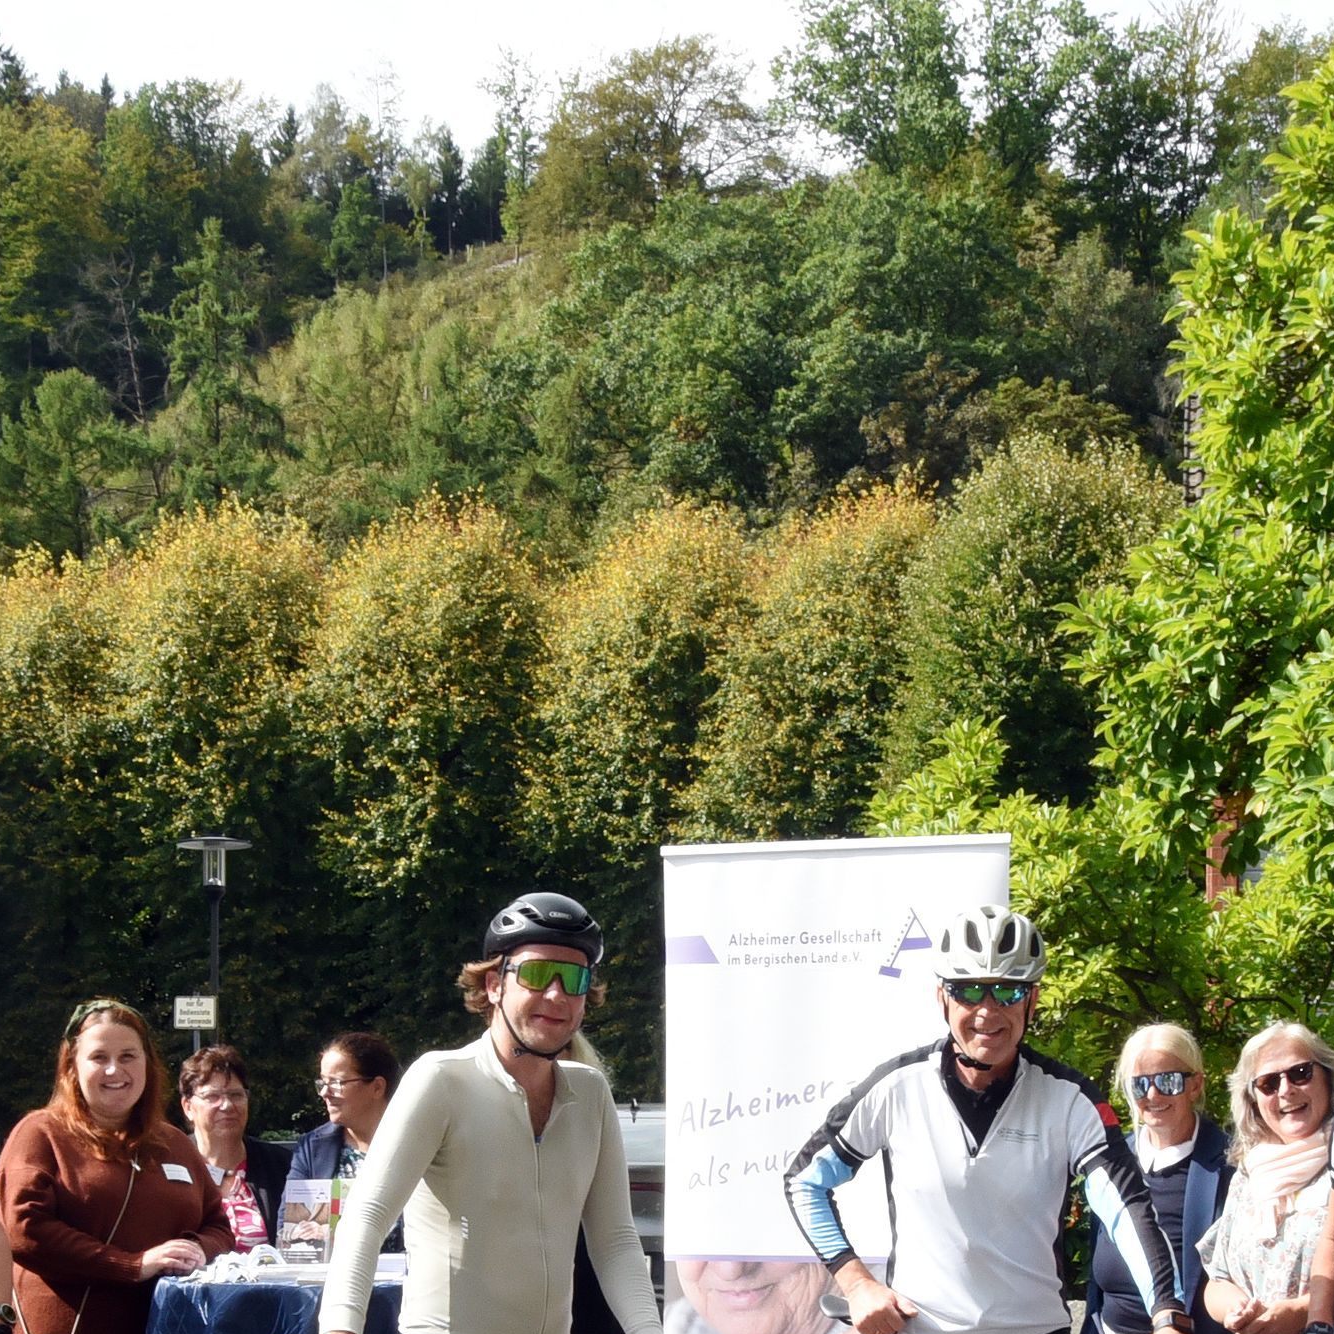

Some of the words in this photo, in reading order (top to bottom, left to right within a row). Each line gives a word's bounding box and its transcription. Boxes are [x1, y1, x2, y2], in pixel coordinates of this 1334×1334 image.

[728, 932, 796, 947] Alzheimer
[799, 928, 882, 945] Gesellschaft
[727, 954, 741, 966] im
[744, 952, 808, 968] Bergischen
[811, 952, 838, 964] Land
[678, 1080, 834, 1136] Alzheimer
[688, 1155, 731, 1190] als
[743, 1149, 796, 1176] nur
